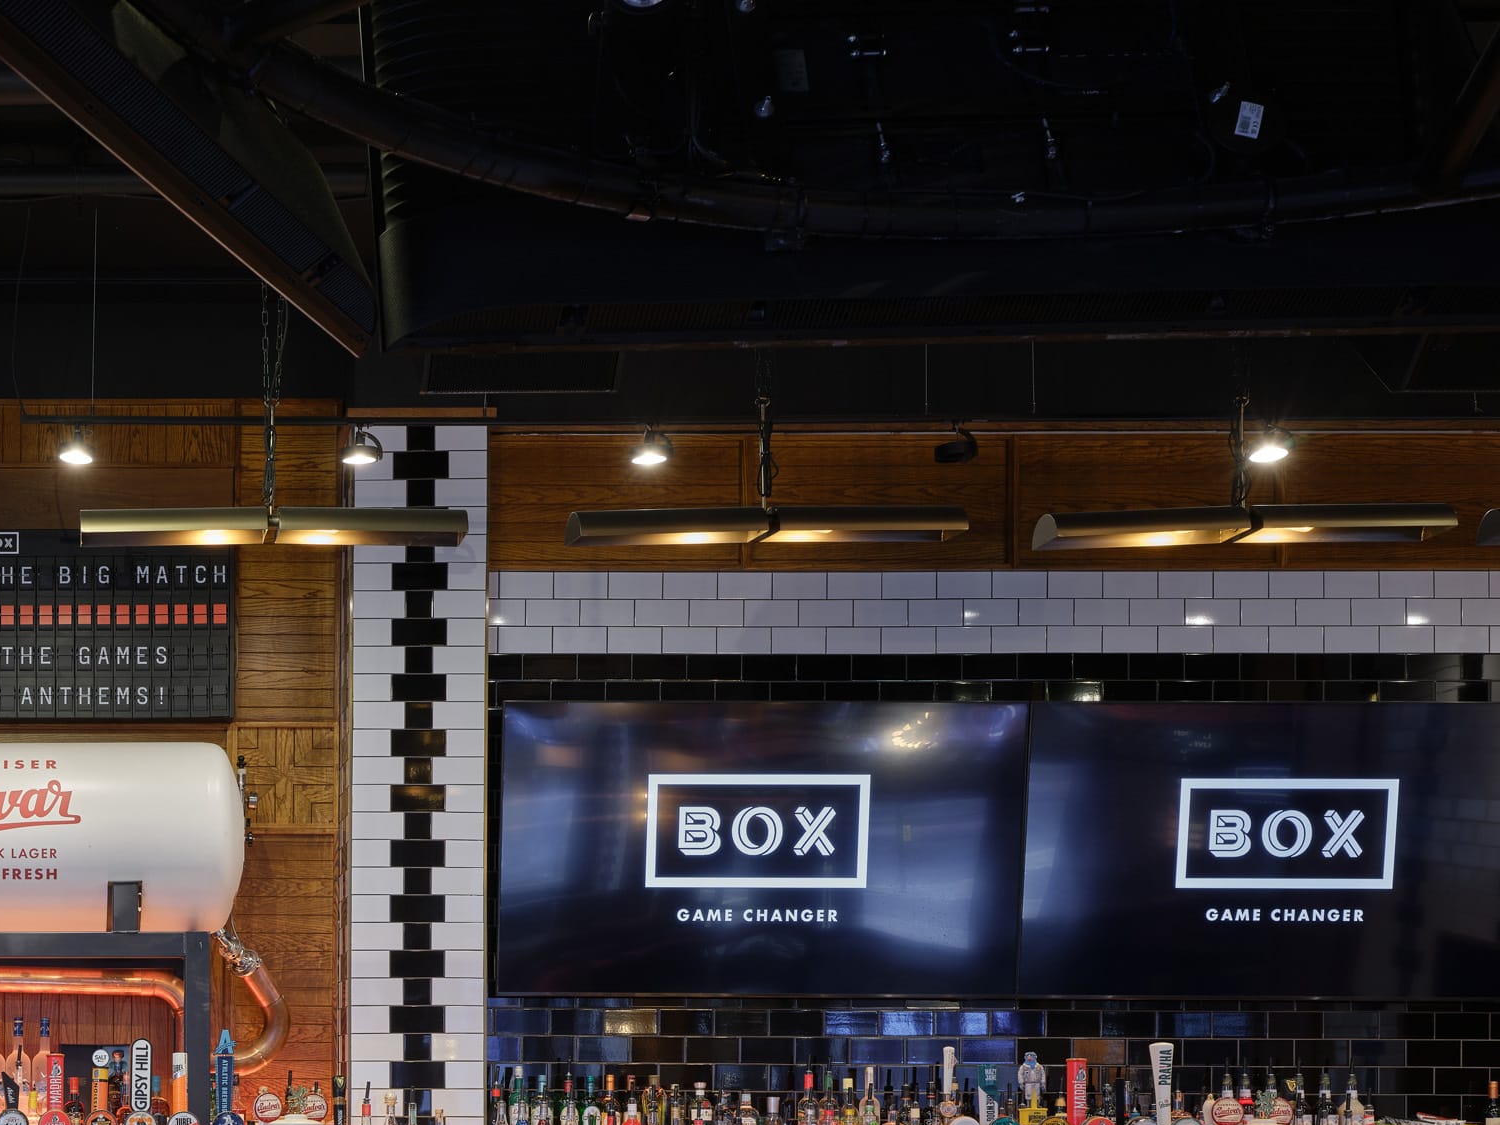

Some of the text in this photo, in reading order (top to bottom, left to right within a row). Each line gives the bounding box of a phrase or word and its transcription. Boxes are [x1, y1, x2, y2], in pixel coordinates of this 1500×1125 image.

[58, 566, 111, 584] BIG
[136, 565, 227, 584] MATCH
[2, 647, 52, 665] THE
[78, 646, 168, 665] GAMES
[21, 687, 165, 705] ANTHEMS!
[678, 806, 837, 856] BOX
[1209, 809, 1365, 858] BOX
[11, 848, 57, 859] LAGER
[2, 868, 58, 880] FRESH
[677, 909, 838, 922] GAME CHANGER
[1206, 908, 1364, 922] GAME CHANGER
[1159, 1049, 1172, 1085] PRAVHA
[135, 1044, 148, 1110] GIPSY HILL
